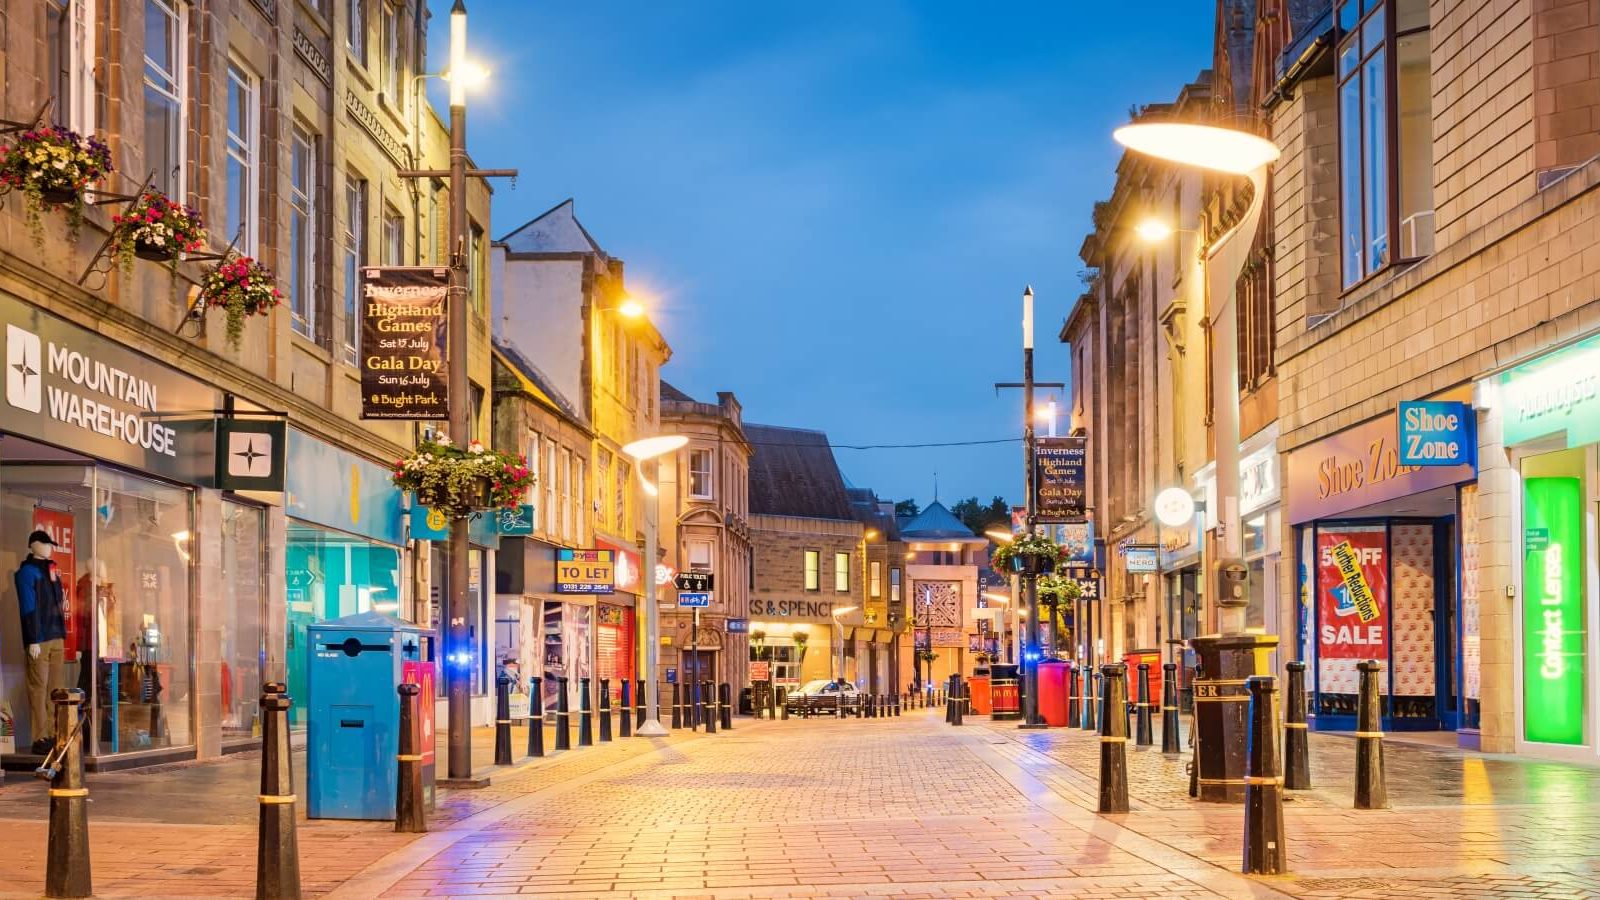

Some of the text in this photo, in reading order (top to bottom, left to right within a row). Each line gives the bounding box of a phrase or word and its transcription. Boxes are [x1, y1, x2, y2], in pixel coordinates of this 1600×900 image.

[368, 303, 443, 320] Highland
[377, 319, 432, 332] Games
[380, 339, 397, 348] Sat
[408, 336, 429, 352] July
[367, 356, 441, 374] Gala Day
[48, 342, 157, 412] MOUNTAIN
[378, 372, 430, 388] Sun 16 July
[380, 392, 413, 408] Bught
[415, 392, 439, 405] Park
[48, 386, 176, 457] WAREHOUSE
[1405, 407, 1459, 432] Shoe
[1036, 447, 1085, 456] Inverness
[1406, 434, 1460, 460] Zone
[1038, 458, 1083, 467] Highland
[1044, 467, 1077, 475] Games
[1319, 455, 1364, 500] Shoe
[1367, 438, 1423, 485] Zo
[1039, 487, 1082, 498] Gala Day
[36, 520, 72, 554] ALE
[562, 567, 610, 579] TO LET
[1334, 542, 1376, 621] Further Reductions
[766, 599, 776, 616] &
[1321, 625, 1383, 645] SALE
